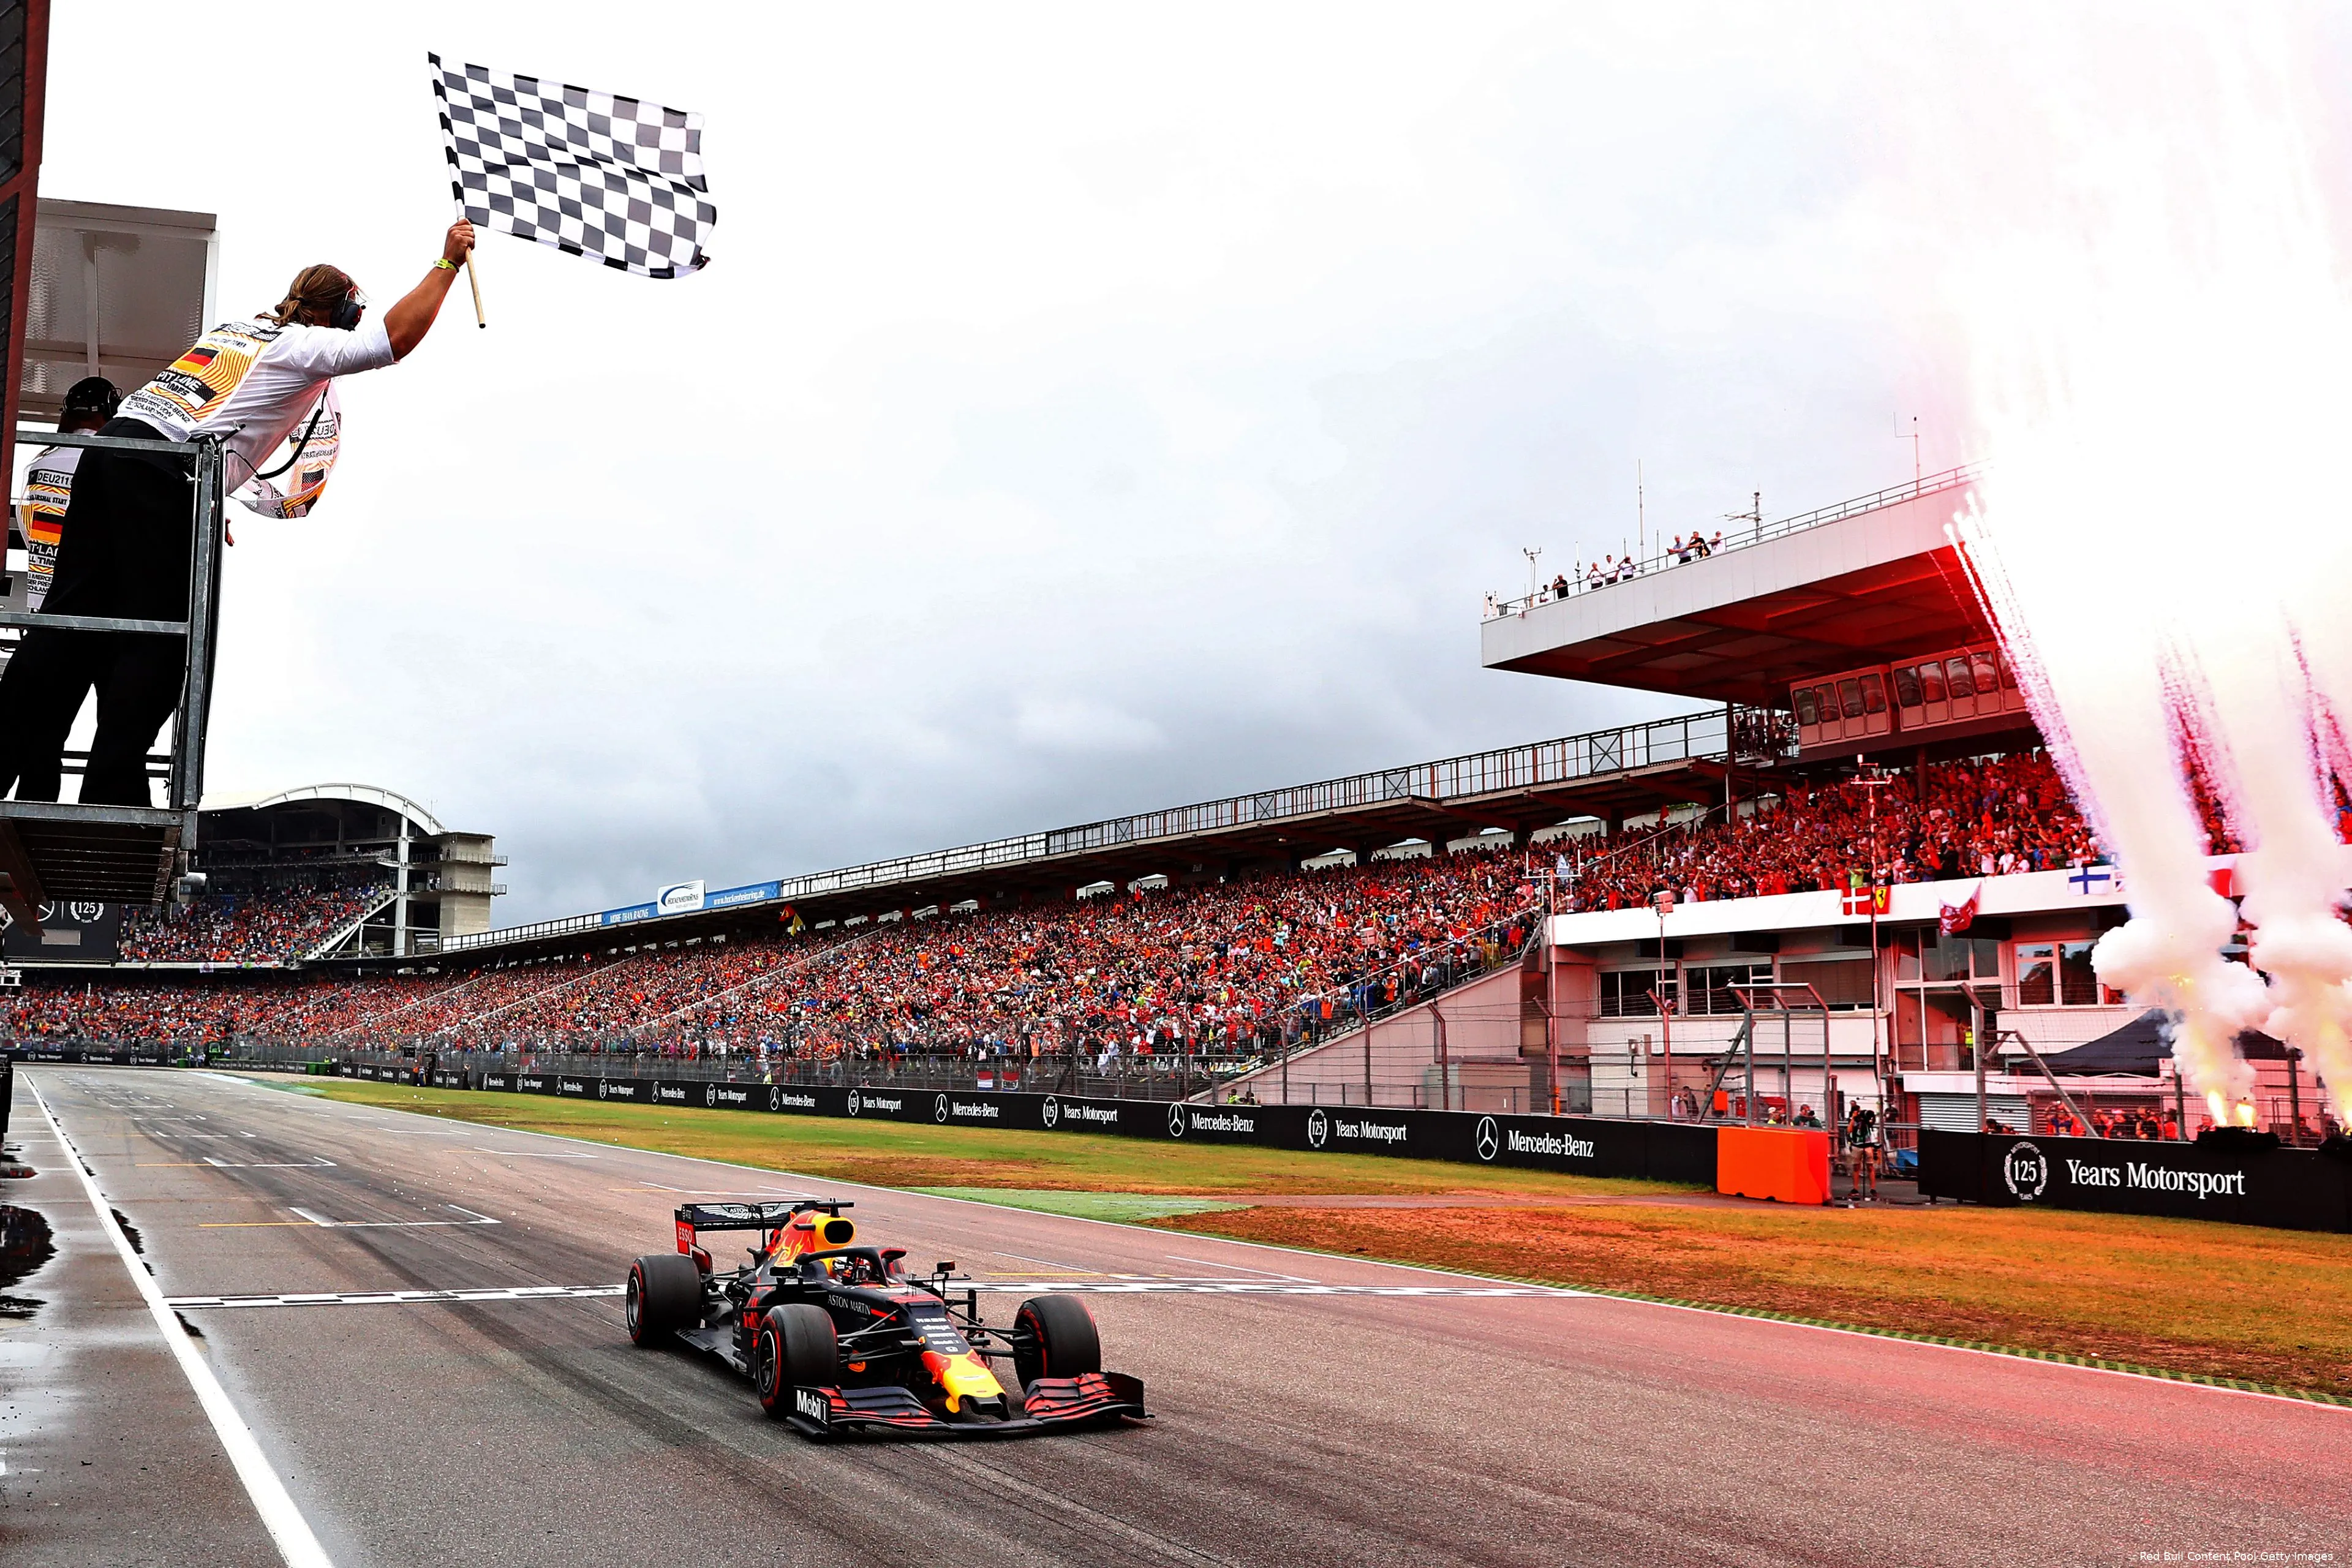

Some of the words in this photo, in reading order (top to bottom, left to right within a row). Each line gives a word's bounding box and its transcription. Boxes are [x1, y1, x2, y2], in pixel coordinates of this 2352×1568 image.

[78, 902, 96, 914] 125
[782, 1093, 815, 1107] Mercedes-Benz
[862, 1096, 876, 1109] Years
[876, 1096, 902, 1113] Motorsport
[952, 1102, 999, 1117] Mercedes-Benz
[1046, 1106, 1054, 1117] 125
[1063, 1104, 1081, 1119] Years
[1082, 1105, 1118, 1125] Motorsport
[1191, 1112, 1254, 1132] Mercedes-Benz
[1312, 1121, 1323, 1136] 125
[1335, 1120, 1359, 1138] Years
[1360, 1121, 1407, 1144] Motorsport
[1508, 1129, 1594, 1158] Mercedes-Benz
[2013, 1159, 2037, 1182] 125
[2065, 1159, 2120, 1187] Years
[2126, 1162, 2246, 1200] Motorsport
[678, 1226, 693, 1243] ESSO
[827, 1294, 848, 1308] ASTON
[850, 1299, 870, 1316] MARTIN
[796, 1389, 821, 1420] Mobil
